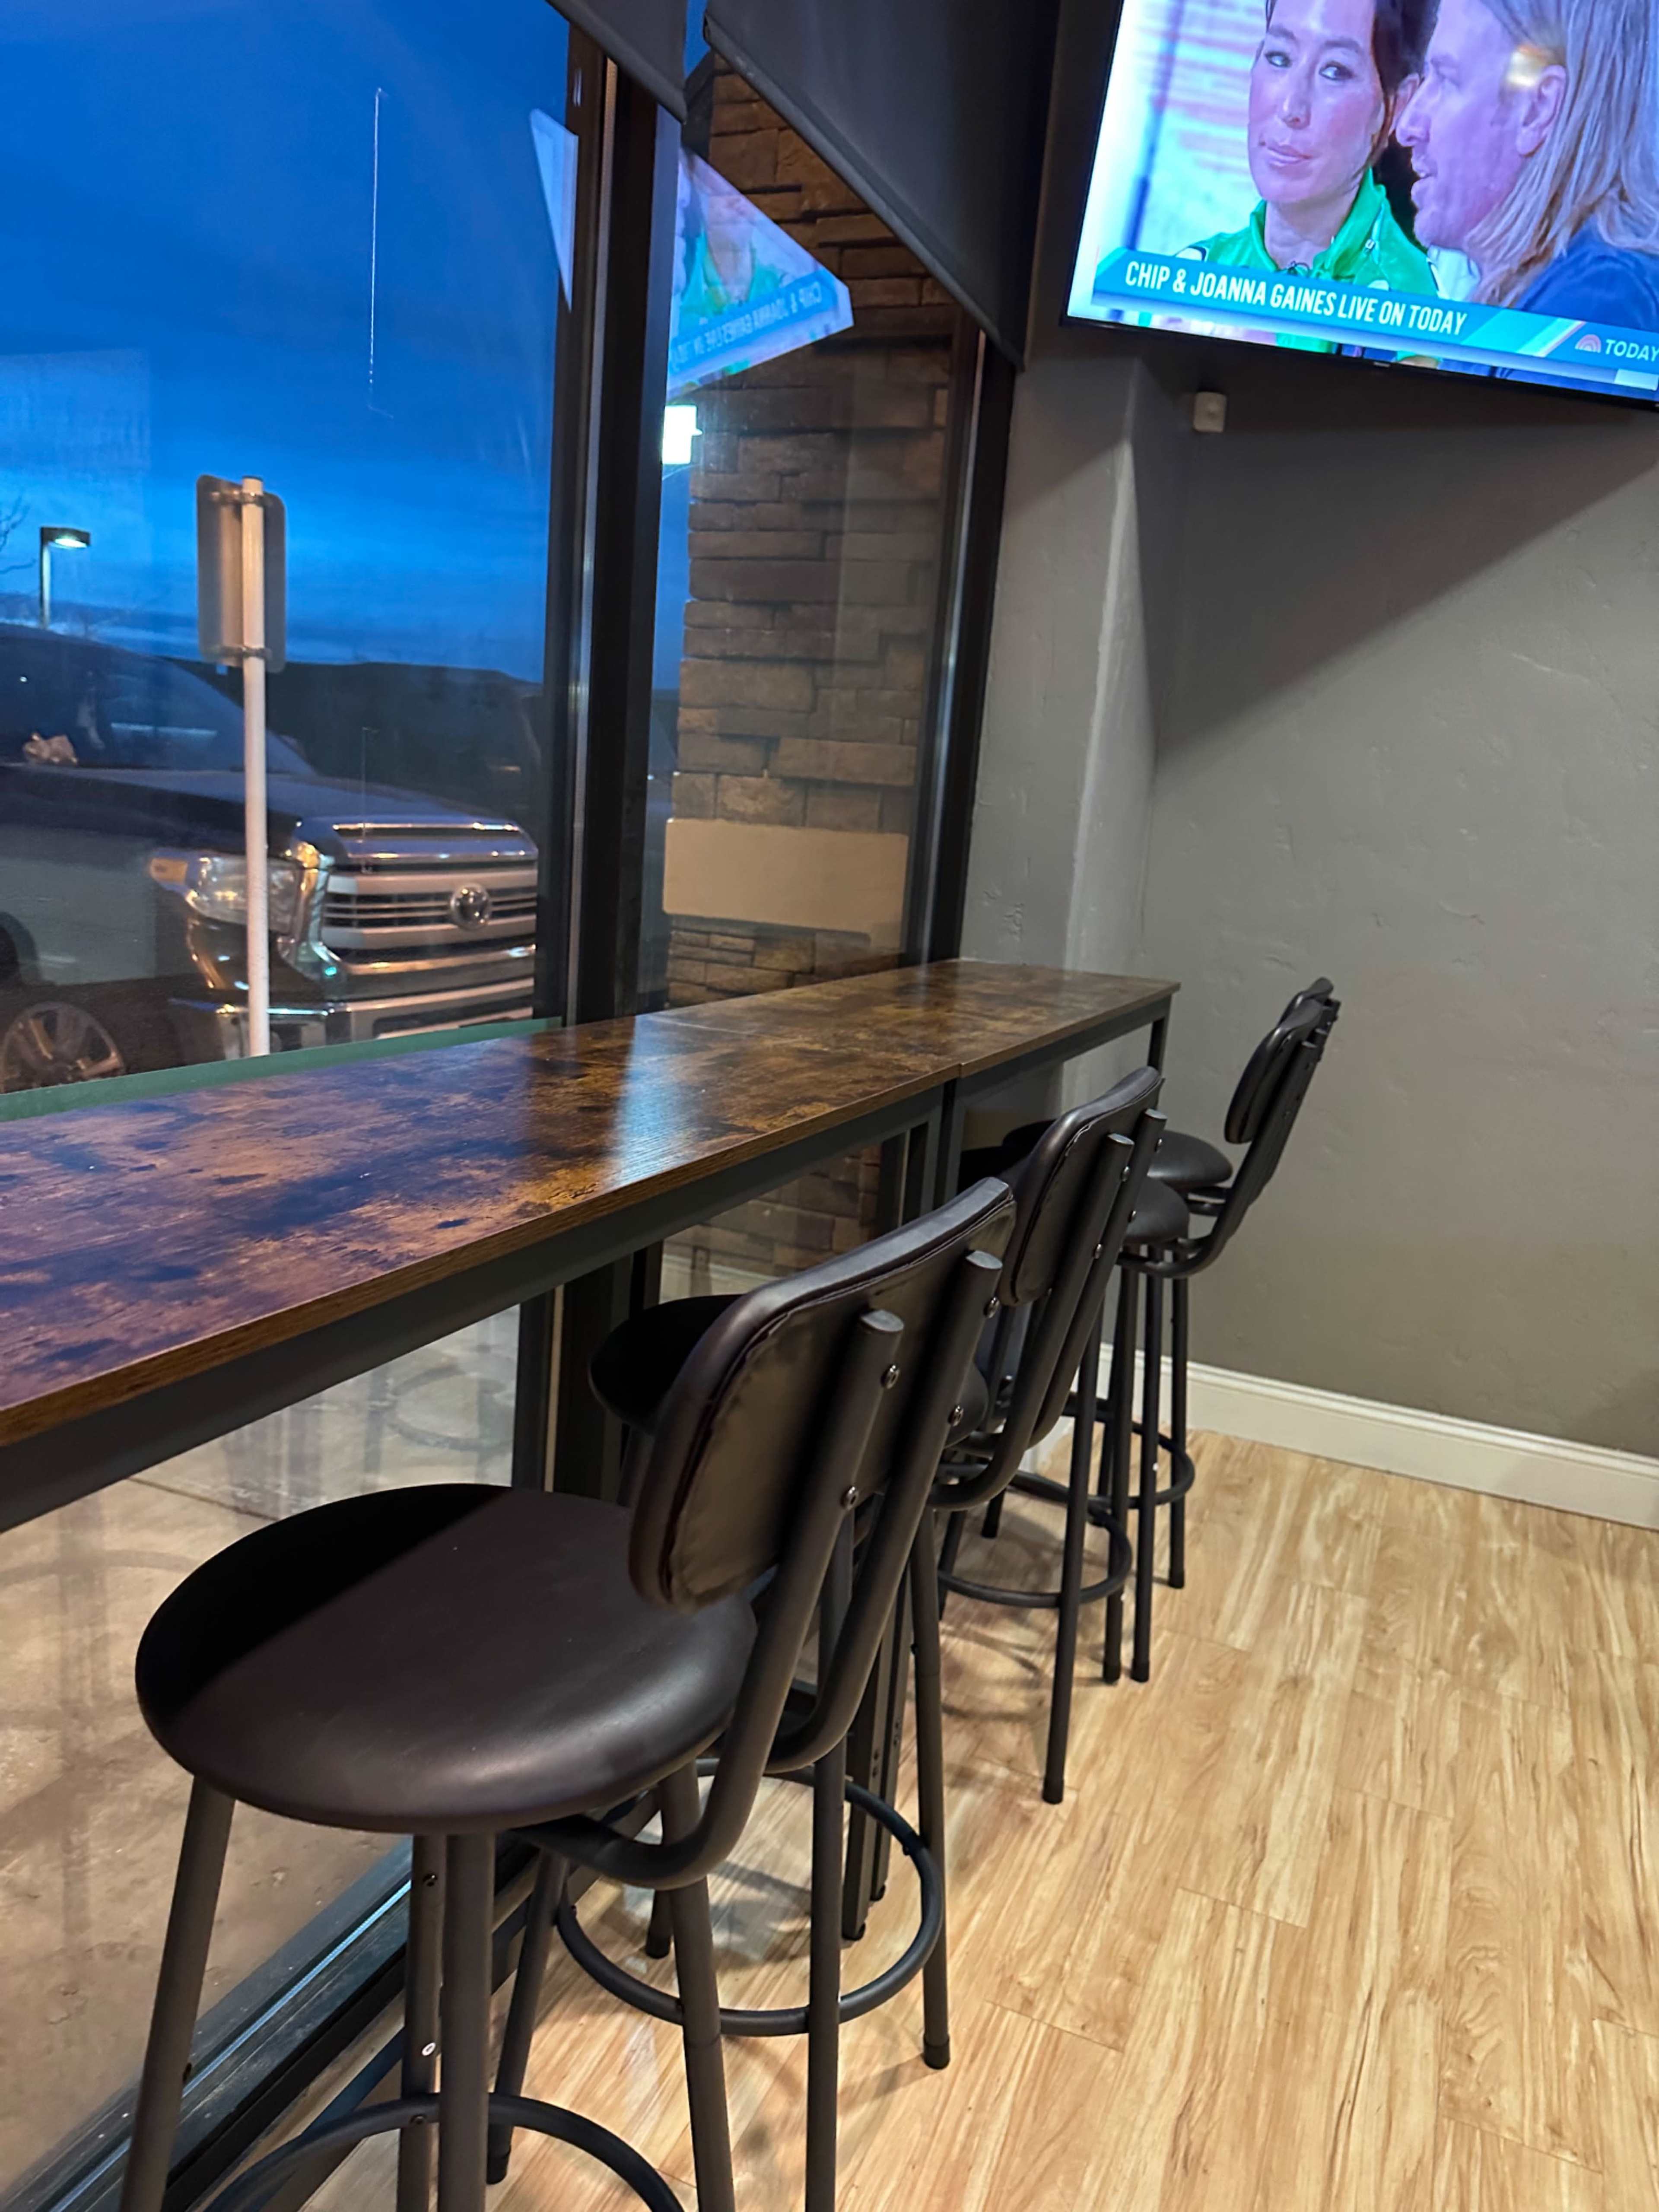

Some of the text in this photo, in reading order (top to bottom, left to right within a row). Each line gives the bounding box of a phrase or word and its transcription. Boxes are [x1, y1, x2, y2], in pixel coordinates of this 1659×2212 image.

[1125, 261, 1467, 335] CHIP & JOANNA GAINES LIVE ON TODAY
[1605, 339, 1659, 362] TODAY
